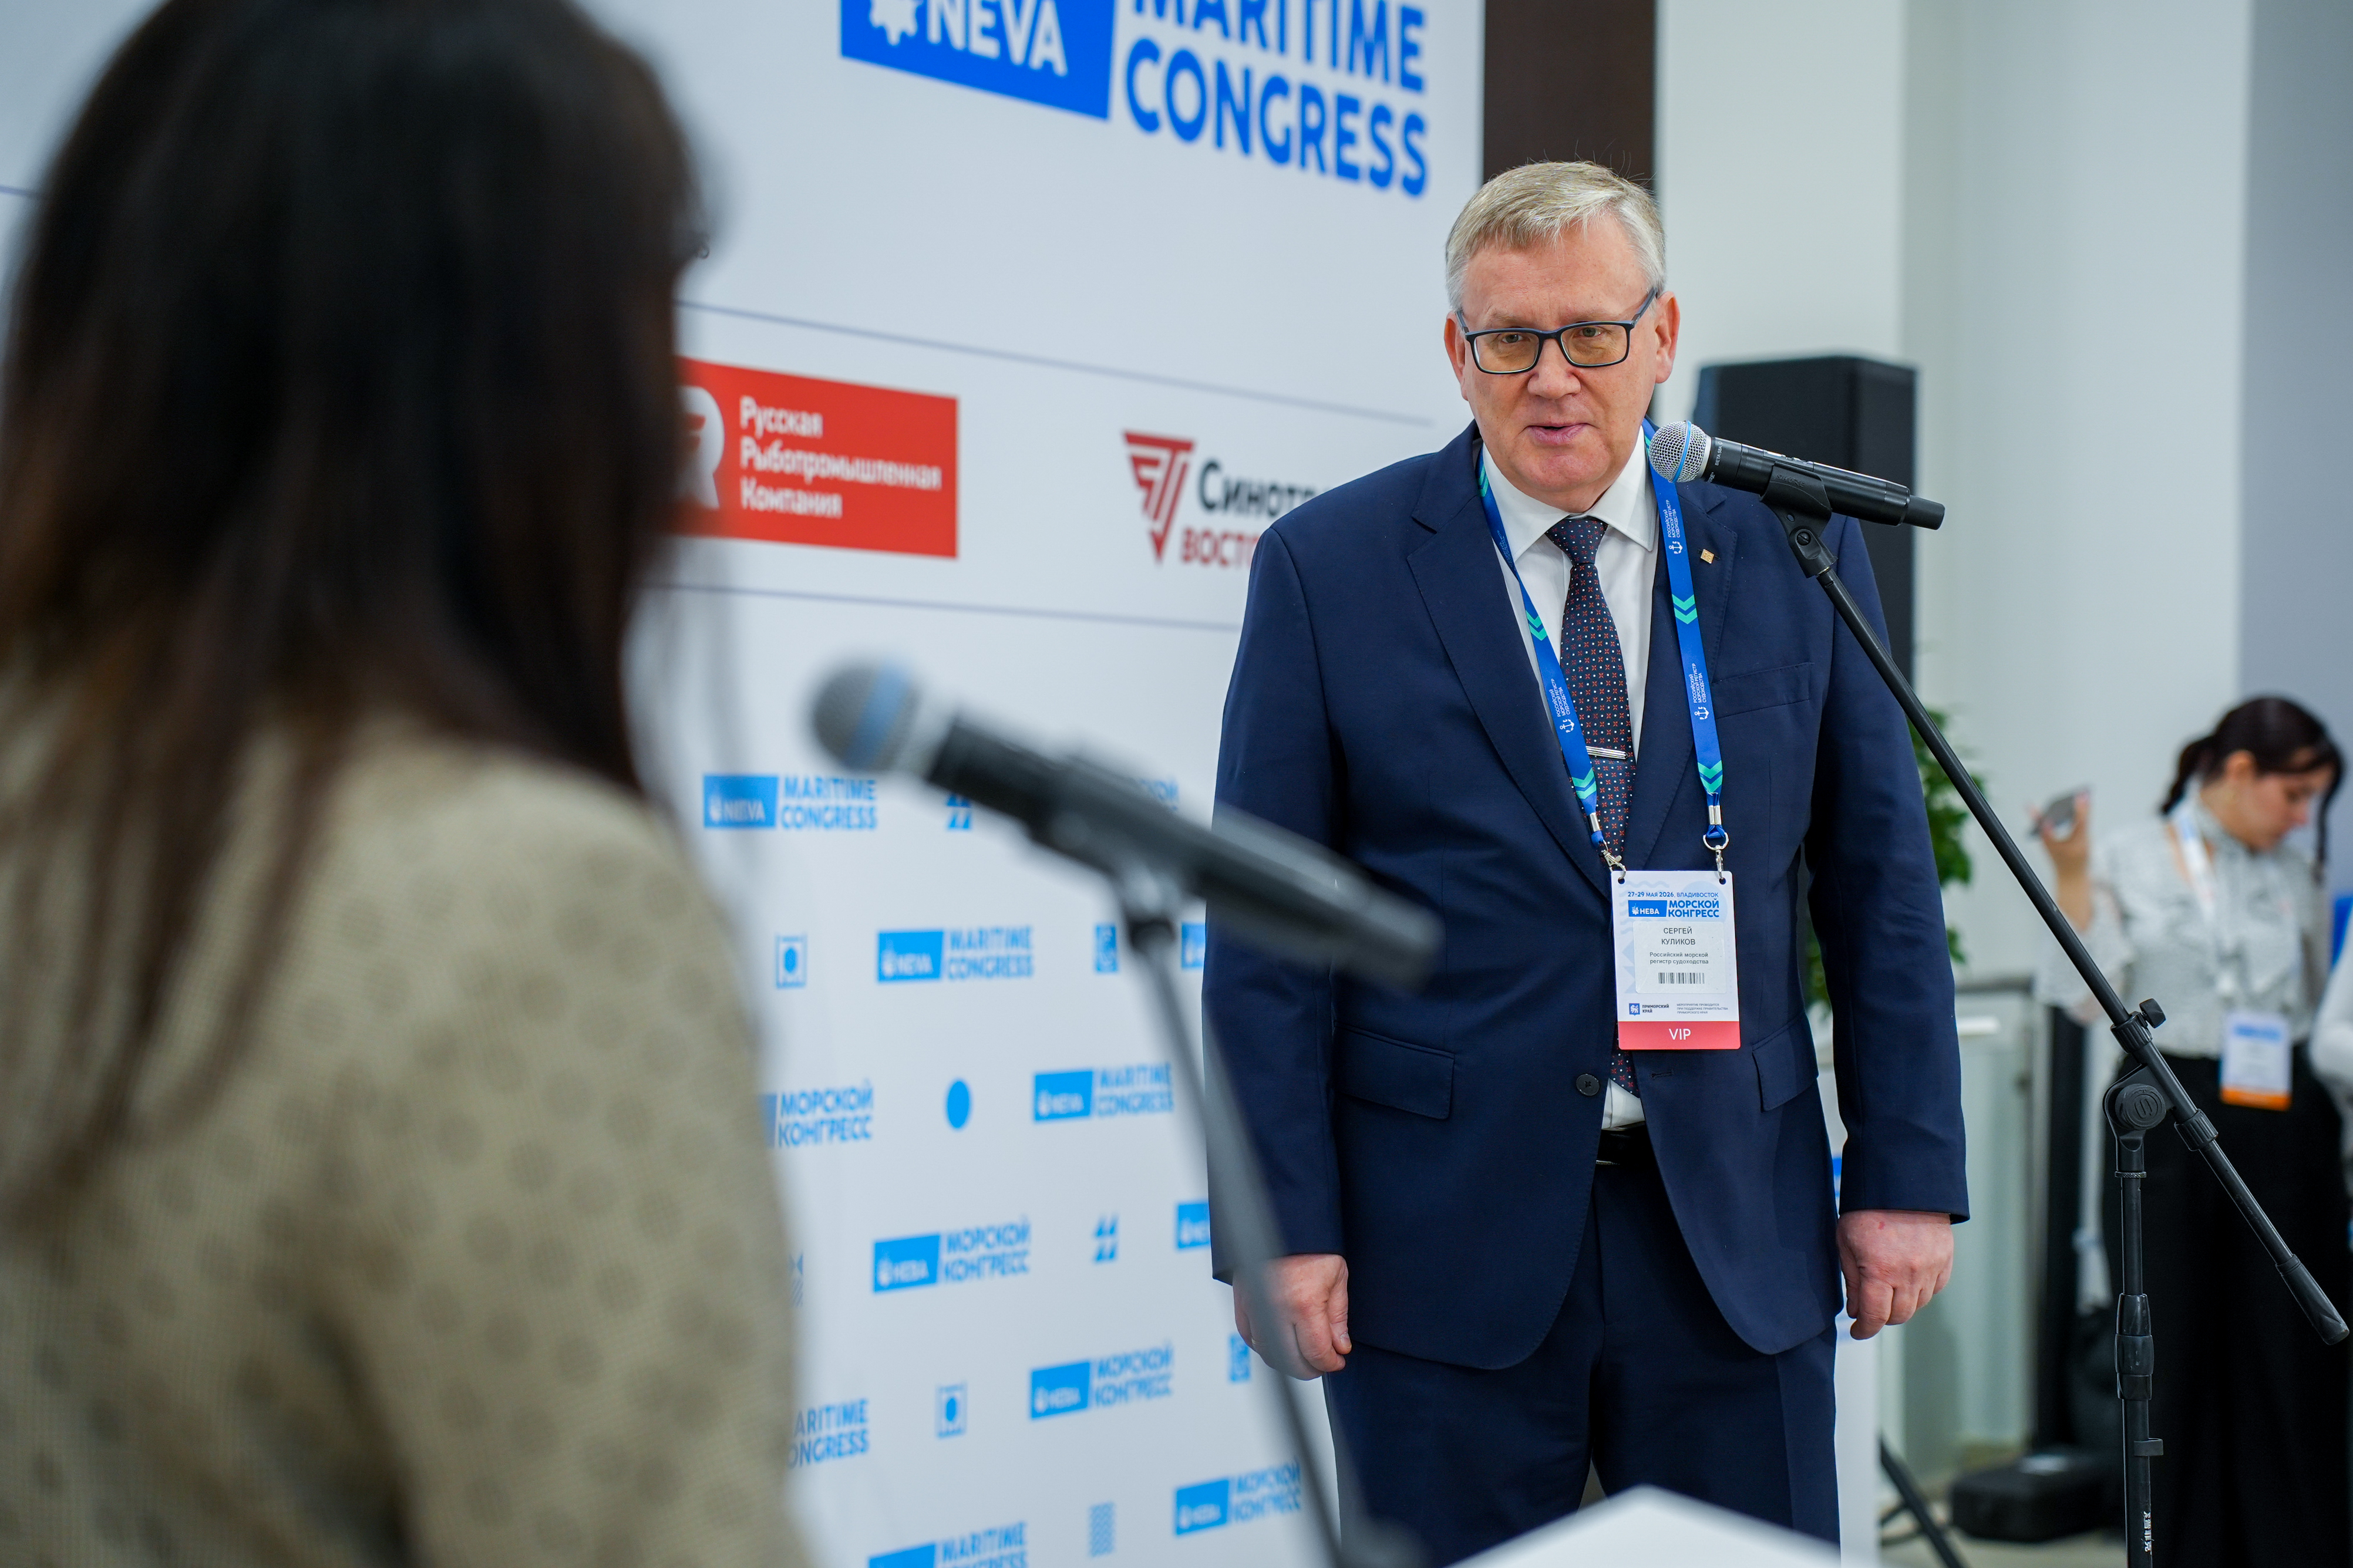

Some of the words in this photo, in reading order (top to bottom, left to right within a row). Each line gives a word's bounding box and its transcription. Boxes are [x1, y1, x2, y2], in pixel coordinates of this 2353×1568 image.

[927, 0, 1068, 76] NEVA
[1132, 0, 1425, 93] RITIME
[1126, 38, 1427, 197] CONGRESS
[739, 394, 823, 439] Русская
[739, 436, 942, 491] Рыбопромышленная
[740, 476, 842, 520] Компания
[1549, 689, 1561, 717] РОССИЙСКИЙ
[1551, 679, 1559, 696] РЕГИСТР
[1558, 686, 1570, 715] СУДОХОДСТВА
[1689, 674, 1698, 703] РОССИЙСКИЙ
[1698, 672, 1706, 703] СУДОХОДСТВА
[1557, 696, 1566, 716] МОРСКОЙ
[784, 776, 876, 800] MARITIME
[782, 805, 877, 829] CONGRESS
[1668, 909, 1719, 918] КОНГРЕСС
[1669, 898, 1719, 908] МОРСКОЙ
[1668, 1028, 1691, 1040] VIP
[780, 1078, 873, 1117] МОРСКОЙ
[777, 1117, 873, 1148] КОНГРЕСС
[944, 1250, 1029, 1283] КОНГРЕСС
[795, 1398, 869, 1437] ARITIME
[788, 1429, 870, 1468] ONGRESS
